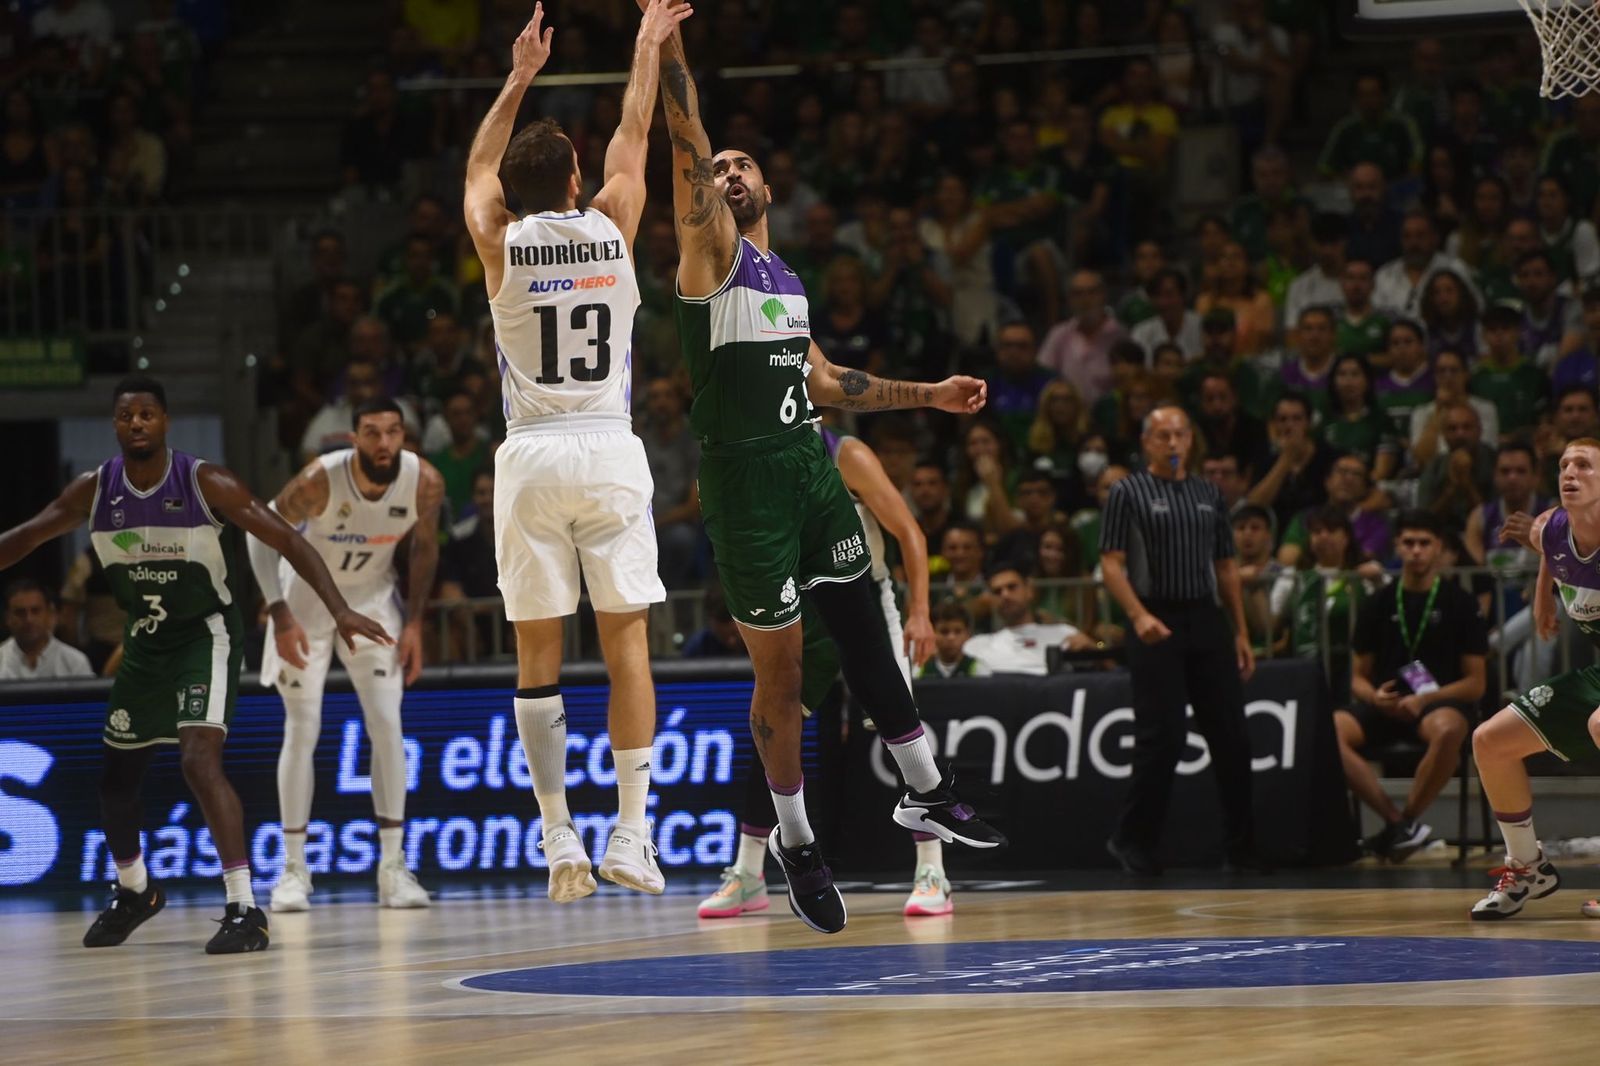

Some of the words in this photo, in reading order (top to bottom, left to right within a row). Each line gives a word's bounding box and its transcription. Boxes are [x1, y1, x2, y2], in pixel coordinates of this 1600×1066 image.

[510, 239, 624, 266] RODRÍGUEZ
[528, 275, 617, 293] AUTOHERO
[533, 303, 612, 384] 13
[779, 385, 798, 424] 6
[141, 543, 185, 556] Unicaja
[327, 533, 403, 546] AUTO
[340, 551, 374, 572] 17
[143, 594, 168, 622] 3
[440, 707, 735, 790] eleccón
[250, 790, 736, 890] gasronmca
